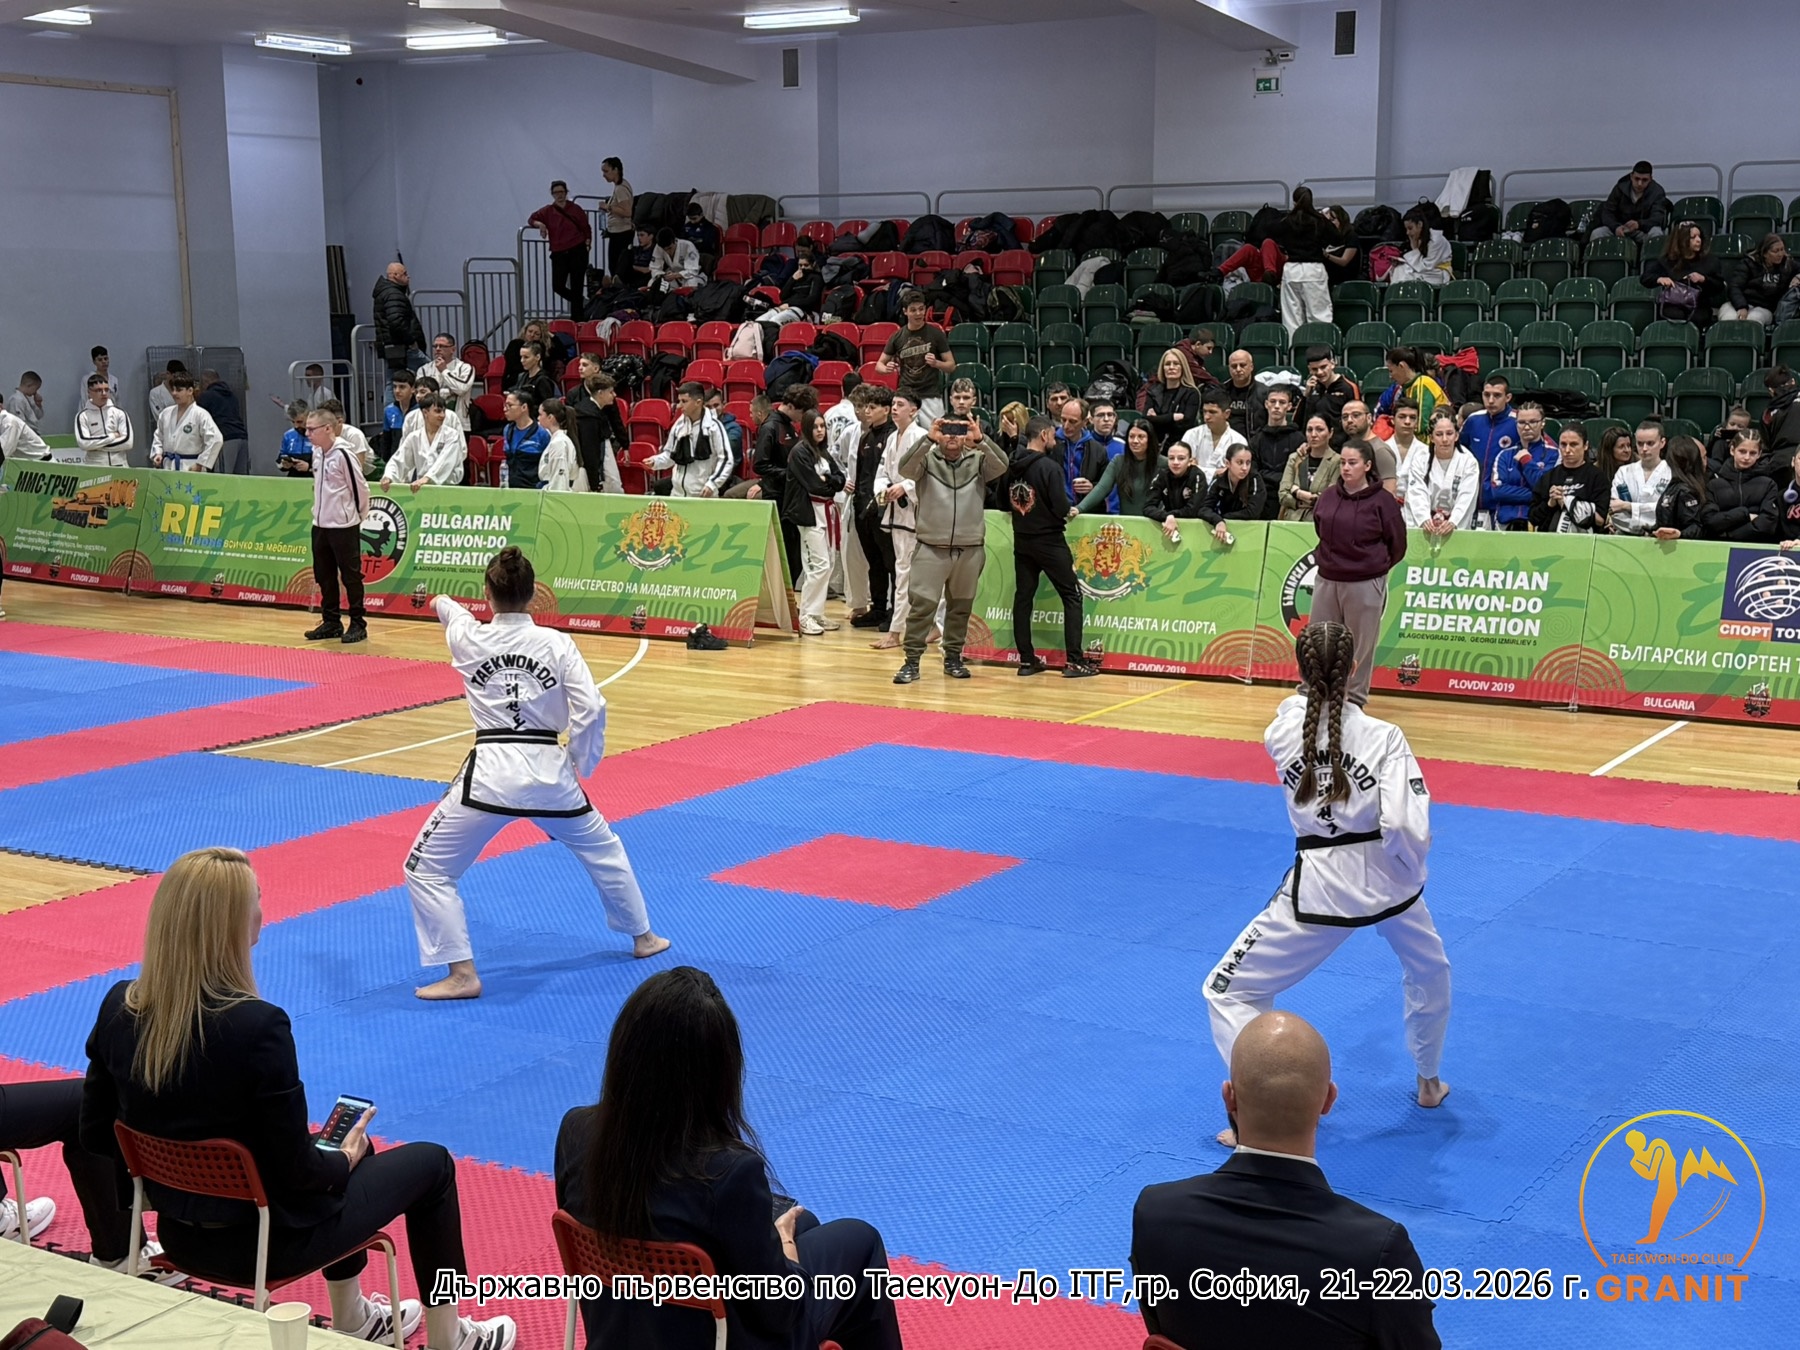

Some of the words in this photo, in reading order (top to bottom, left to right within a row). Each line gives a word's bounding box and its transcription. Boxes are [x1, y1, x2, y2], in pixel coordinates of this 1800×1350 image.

[14, 471, 79, 498] ММС-ГРУП
[160, 502, 223, 537] RIF
[420, 513, 512, 531] BULGARIAN
[254, 542, 264, 551] за
[266, 541, 307, 554] мебелите
[418, 533, 507, 549] TAEKWON-DO
[414, 549, 499, 566] FEDERATIO
[364, 559, 381, 574] TF
[1405, 566, 1549, 591] BULGARIAN
[160, 583, 187, 594] BULGARIA
[553, 576, 623, 593] МИНИСТЕРСТВО
[625, 581, 638, 594] НА
[639, 582, 691, 599] МЛАДЕЖТА
[693, 586, 700, 598] И
[701, 587, 737, 601] СПОРТА
[363, 598, 384, 607] LGARIA
[470, 603, 486, 612] 2019
[1404, 591, 1543, 614] TAEKWON-DO
[568, 618, 601, 629] BULGARIA
[985, 606, 1065, 624] МИНЕРСТВ
[1093, 616, 1158, 632] МЛАДЕЖТА
[1161, 619, 1169, 631] И
[1171, 620, 1217, 635] СПОРТА
[1399, 611, 1541, 637] FEDERATION
[664, 625, 691, 635] PLOV
[1719, 624, 1771, 638] СПОРТ
[1608, 643, 1707, 667] БЪЛГАРСКИ
[1711, 651, 1792, 674] СПОРТЕН
[471, 654, 557, 691] TAEKWON-DO
[1128, 662, 1164, 672] PLOVDIV
[1164, 664, 1187, 674] 2019
[505, 673, 519, 681] ITF
[1448, 678, 1490, 691] PLOVDIV
[1491, 681, 1515, 693] 2019
[1643, 696, 1695, 711] BULGARIA
